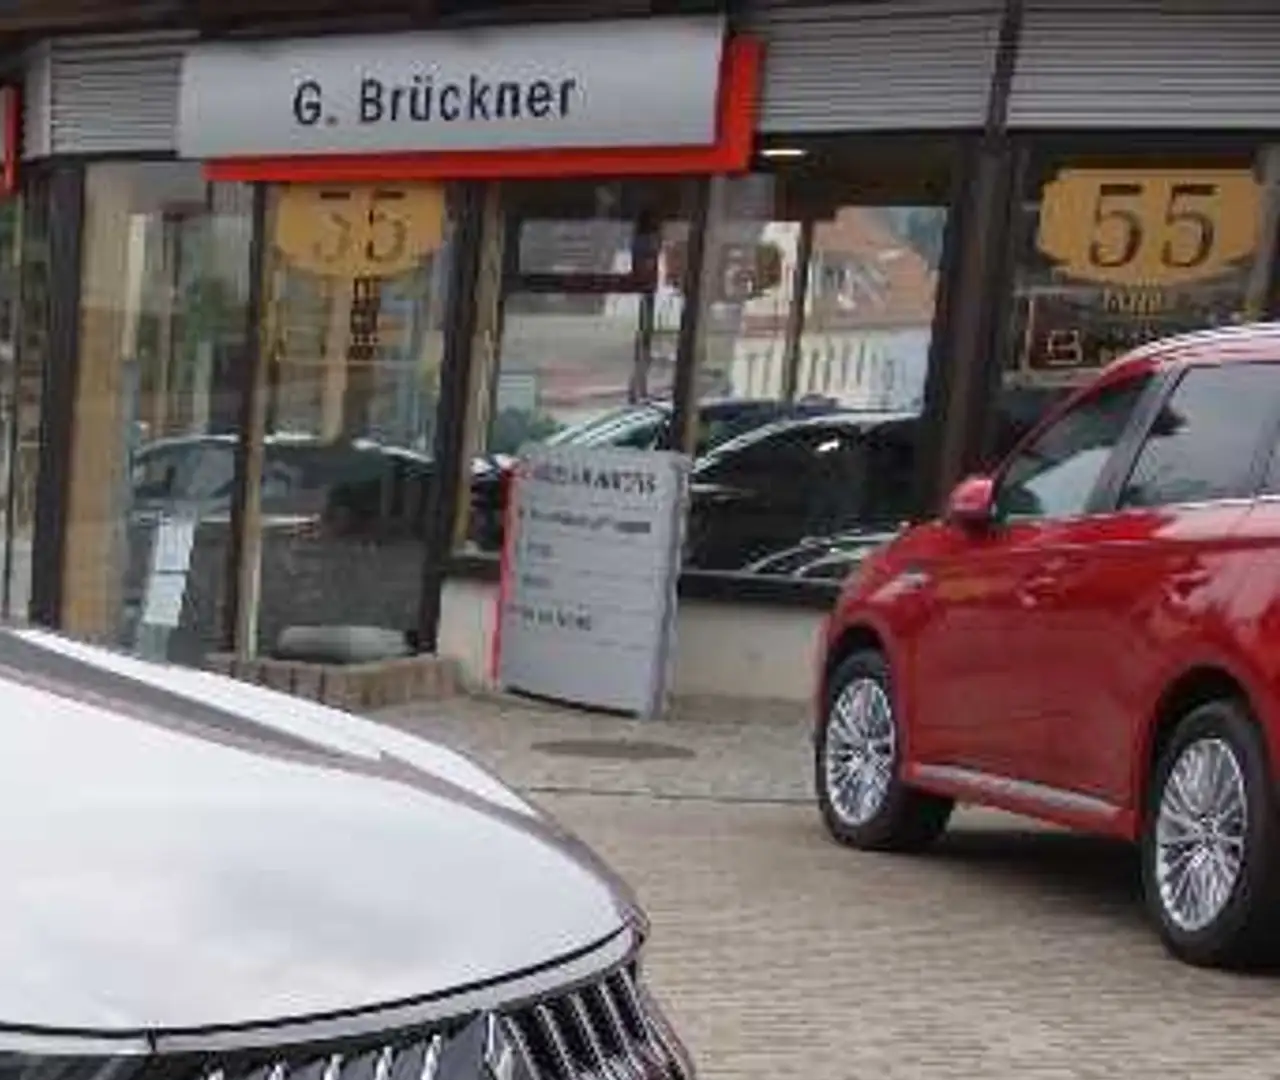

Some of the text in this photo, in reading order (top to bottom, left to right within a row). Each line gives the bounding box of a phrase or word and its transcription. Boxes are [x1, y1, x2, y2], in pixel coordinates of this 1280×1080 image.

[293, 73, 576, 125] G. Brückner
[1088, 183, 1220, 268] 55
